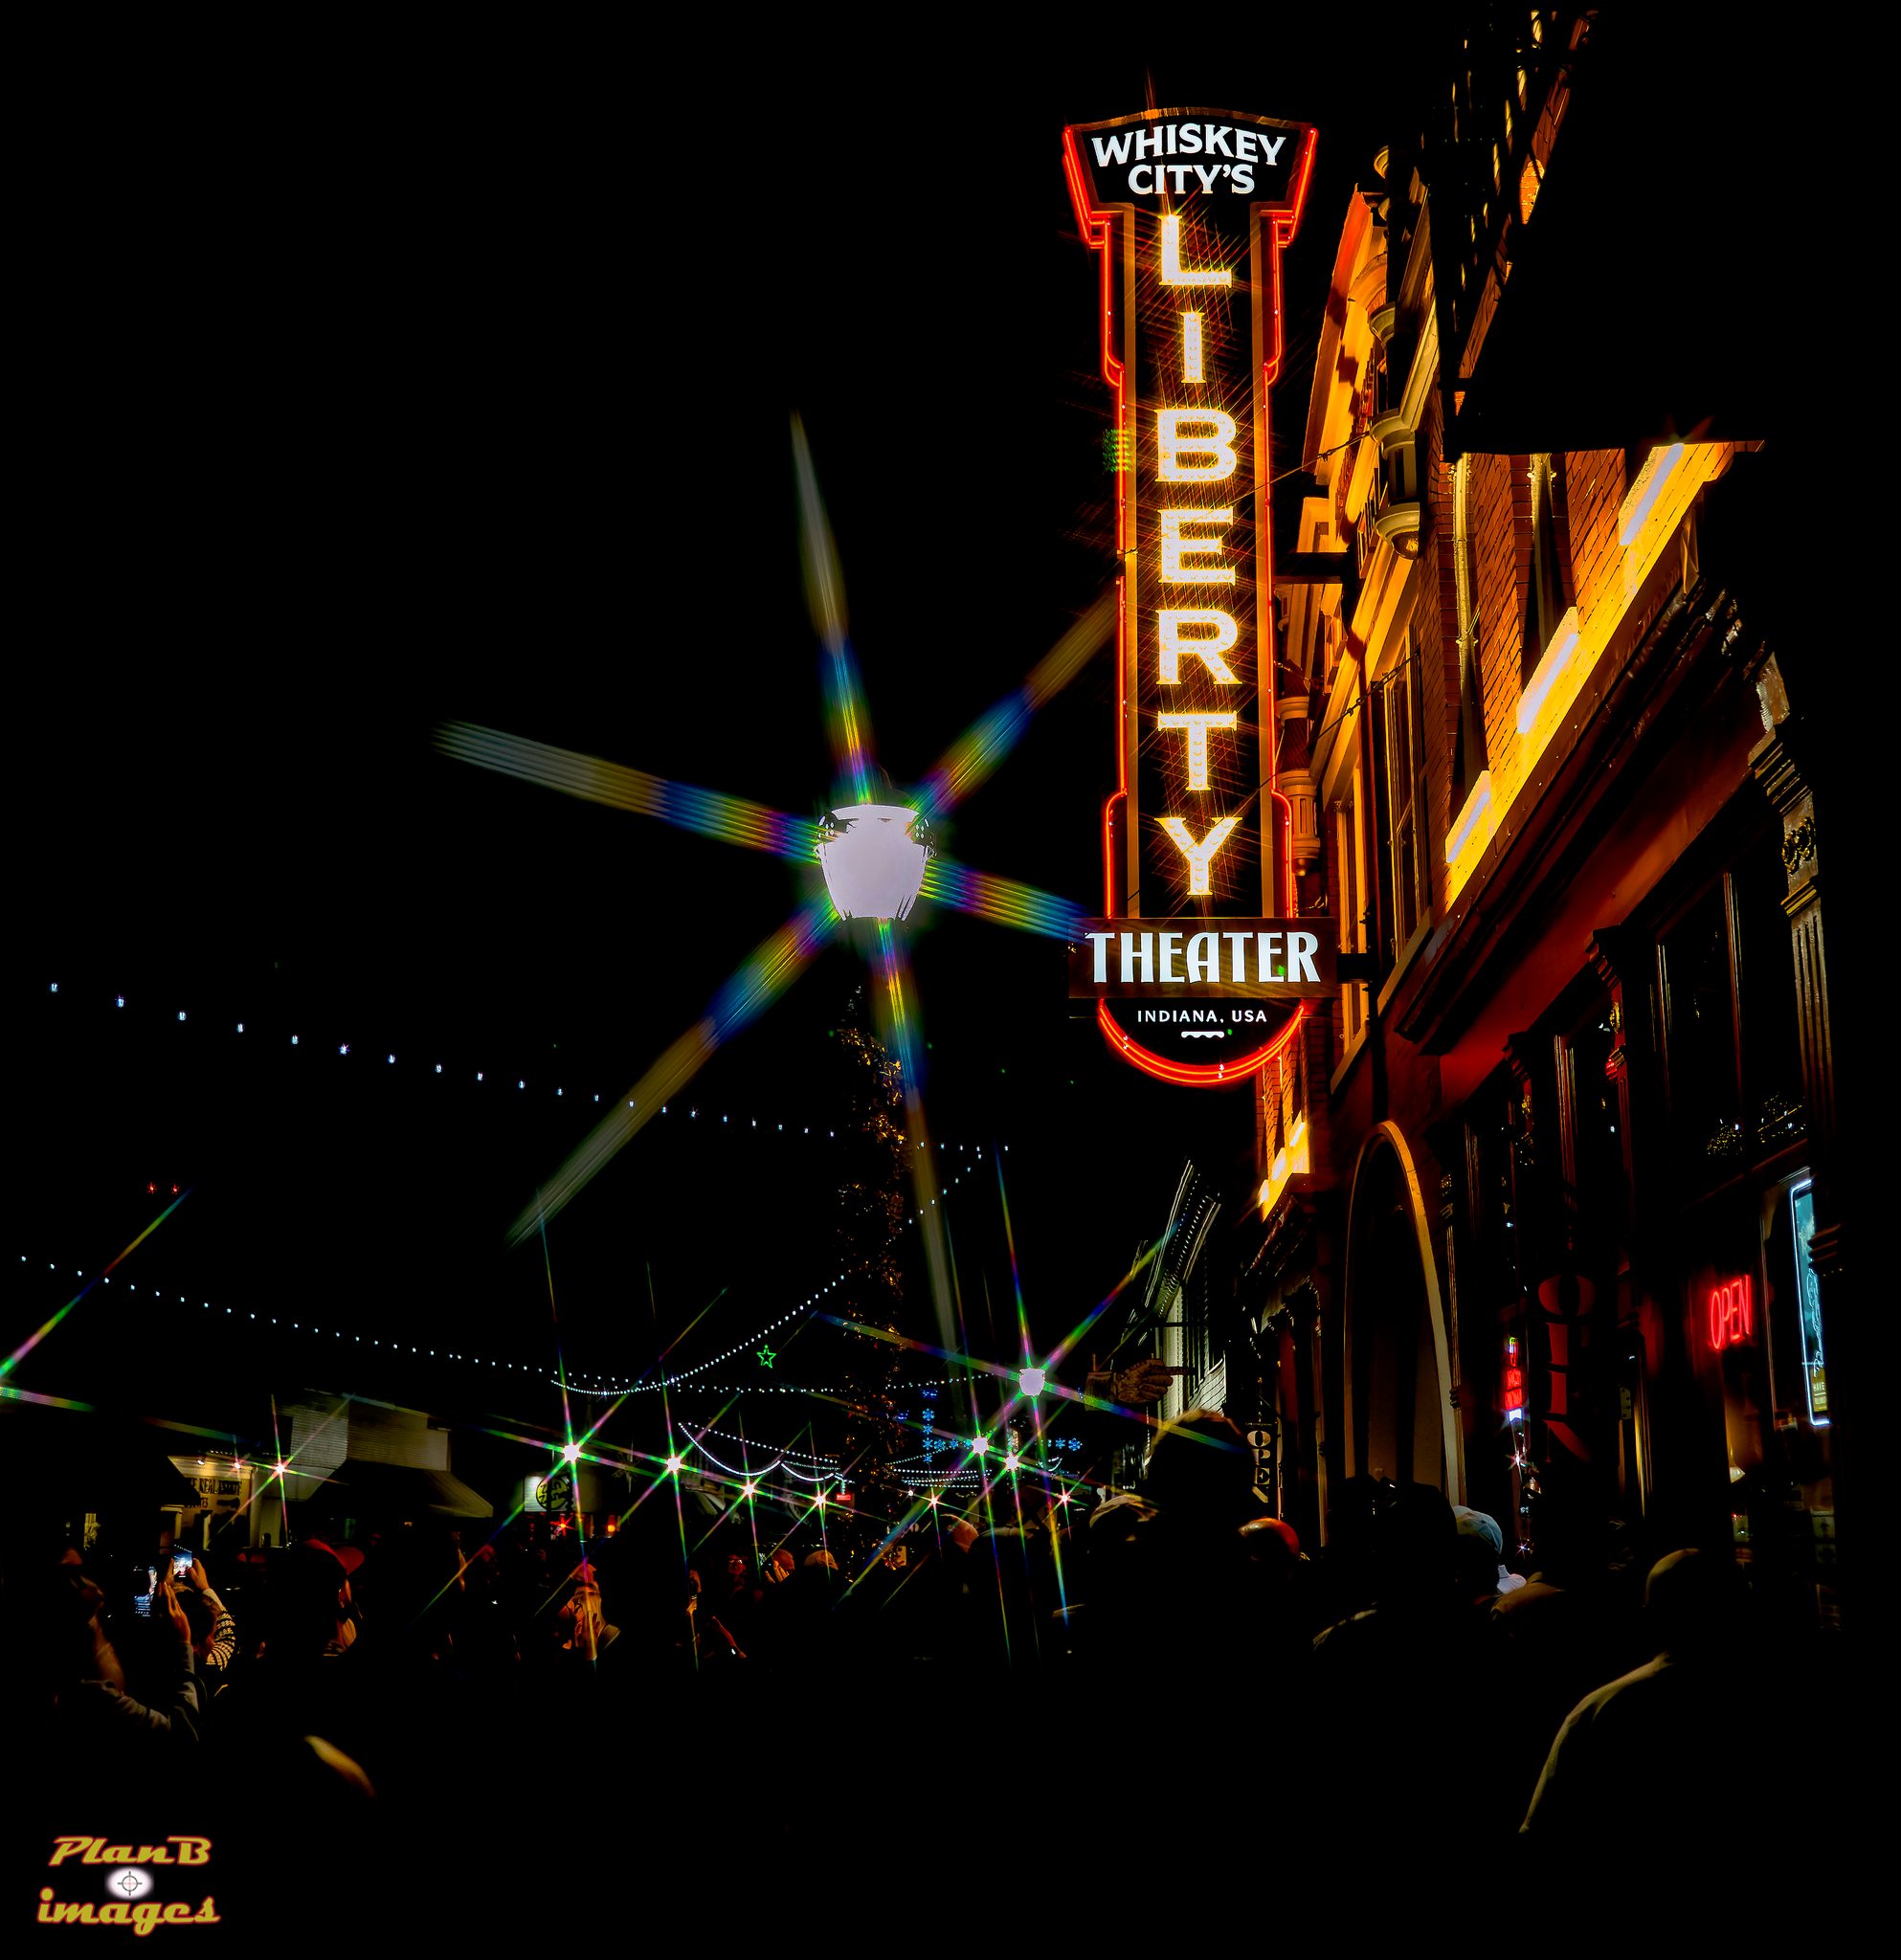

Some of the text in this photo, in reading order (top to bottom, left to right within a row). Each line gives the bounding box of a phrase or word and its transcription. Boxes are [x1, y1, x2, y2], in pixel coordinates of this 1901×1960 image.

[1091, 122, 1286, 167] WHISKEY
[1128, 165, 1255, 195] CITY'S
[1155, 213, 1242, 897] LIBERTY
[1085, 932, 1321, 983] THEATER
[1137, 1010, 1267, 1024] INDIANA, USA
[1710, 1274, 1750, 1349] OPEN
